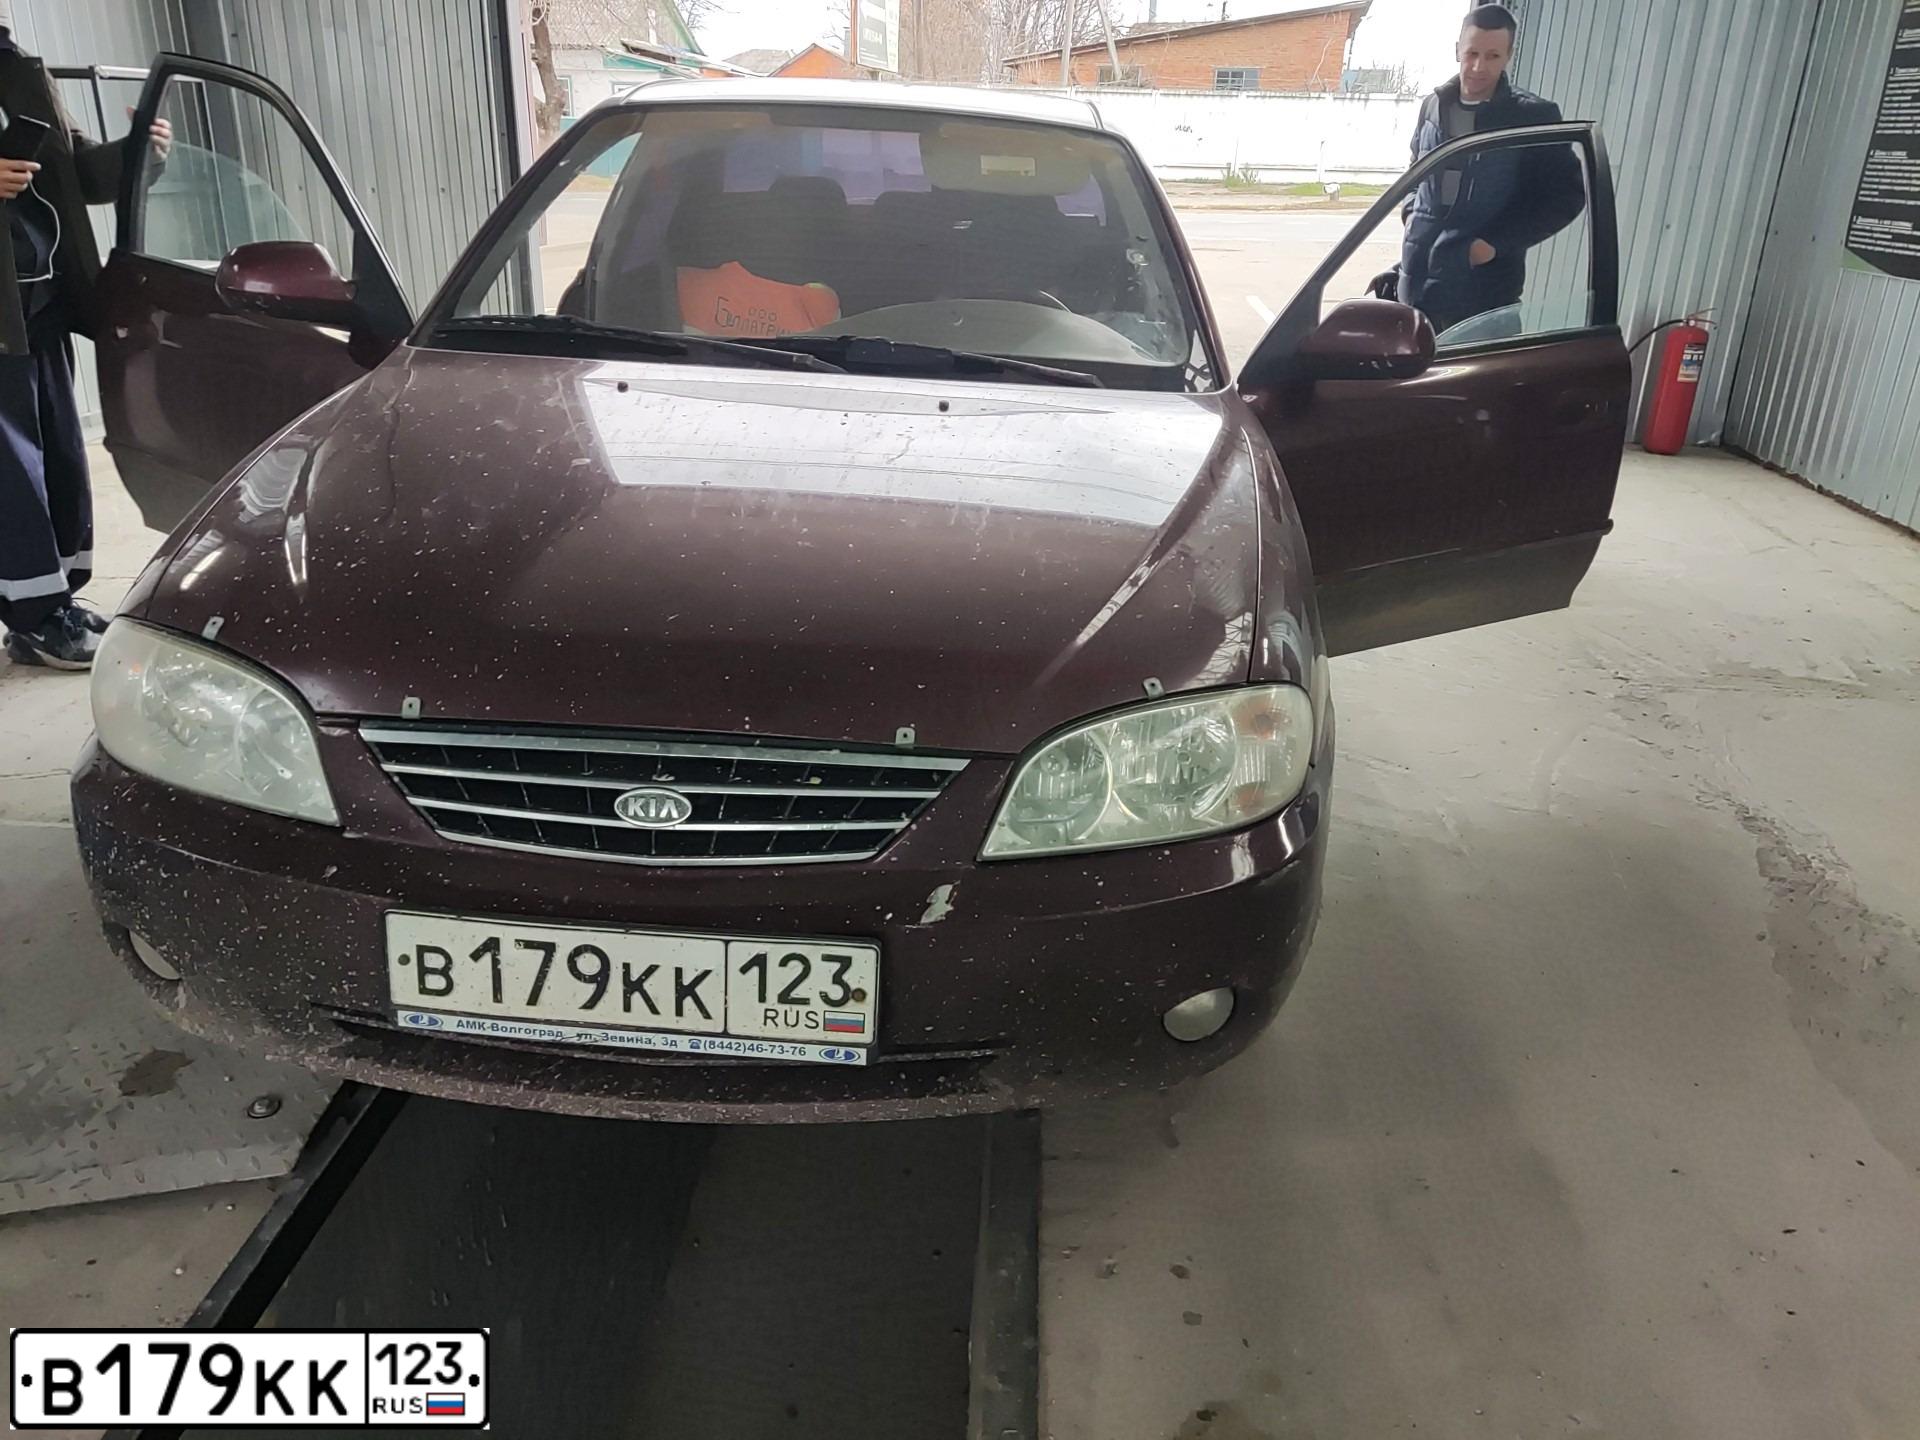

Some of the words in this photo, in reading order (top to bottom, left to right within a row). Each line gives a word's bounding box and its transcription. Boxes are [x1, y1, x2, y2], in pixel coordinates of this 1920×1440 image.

[627, 797, 680, 819] KIA
[415, 936, 713, 1020] В179КК
[739, 952, 852, 1008] 123
[763, 1008, 820, 1030] RUS
[601, 1031, 656, 1047] Зевина,
[703, 1038, 807, 1057] (8442)46-73-76
